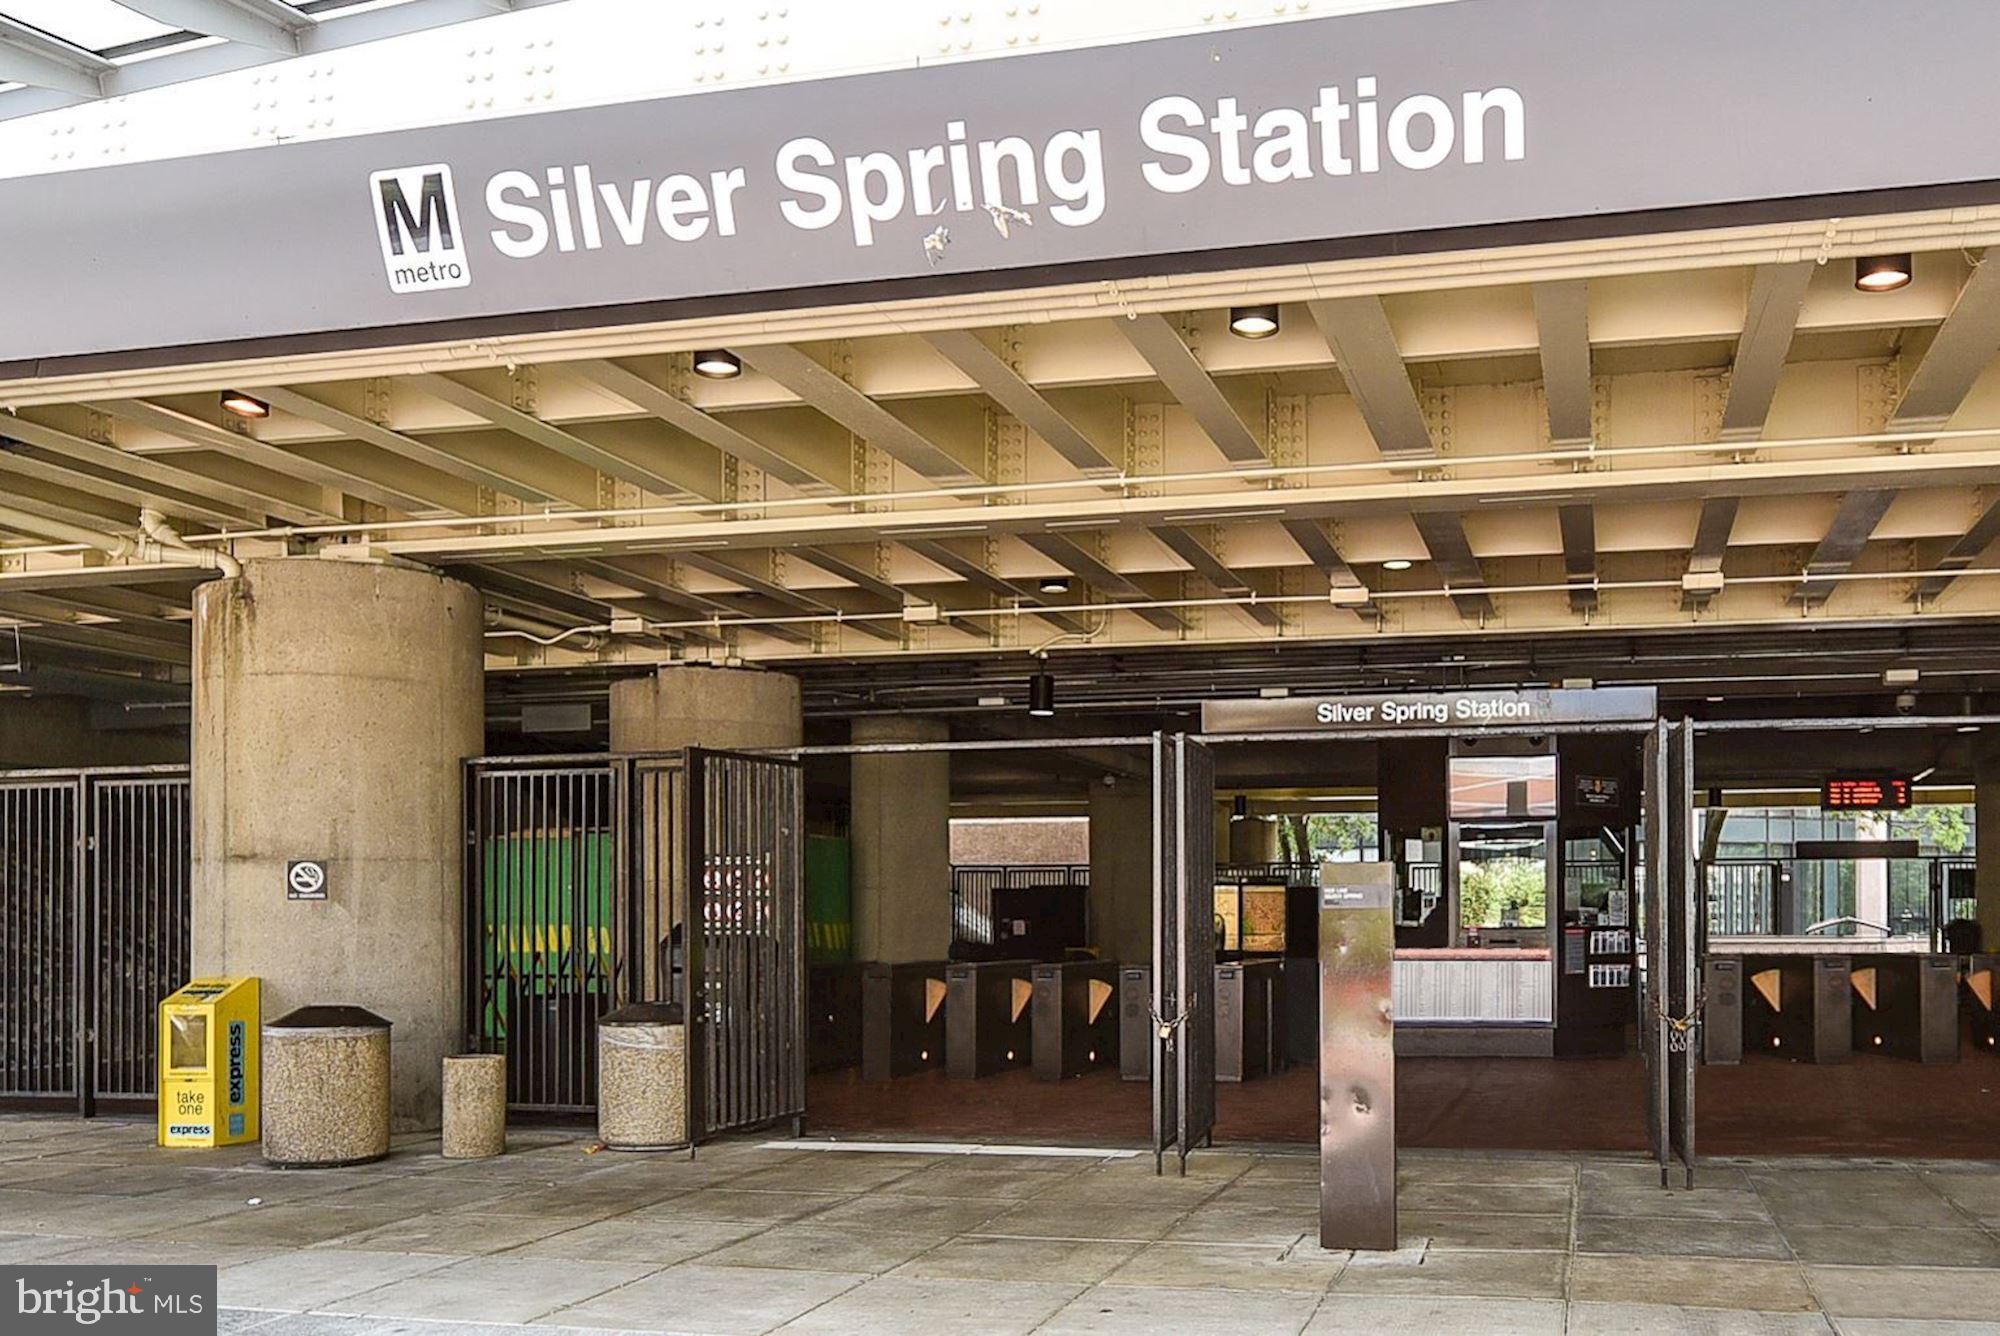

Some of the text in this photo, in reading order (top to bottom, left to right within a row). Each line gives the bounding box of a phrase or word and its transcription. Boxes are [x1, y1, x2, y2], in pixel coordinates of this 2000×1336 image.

[485, 76, 1526, 259] Silver Spring Station
[379, 172, 455, 256] M
[394, 261, 462, 286] metro
[1316, 697, 1531, 725] Silver Spring Station
[230, 1022, 244, 1104] express
[176, 1089, 205, 1104] take
[178, 1103, 203, 1116] one
[169, 1125, 211, 1136] express
